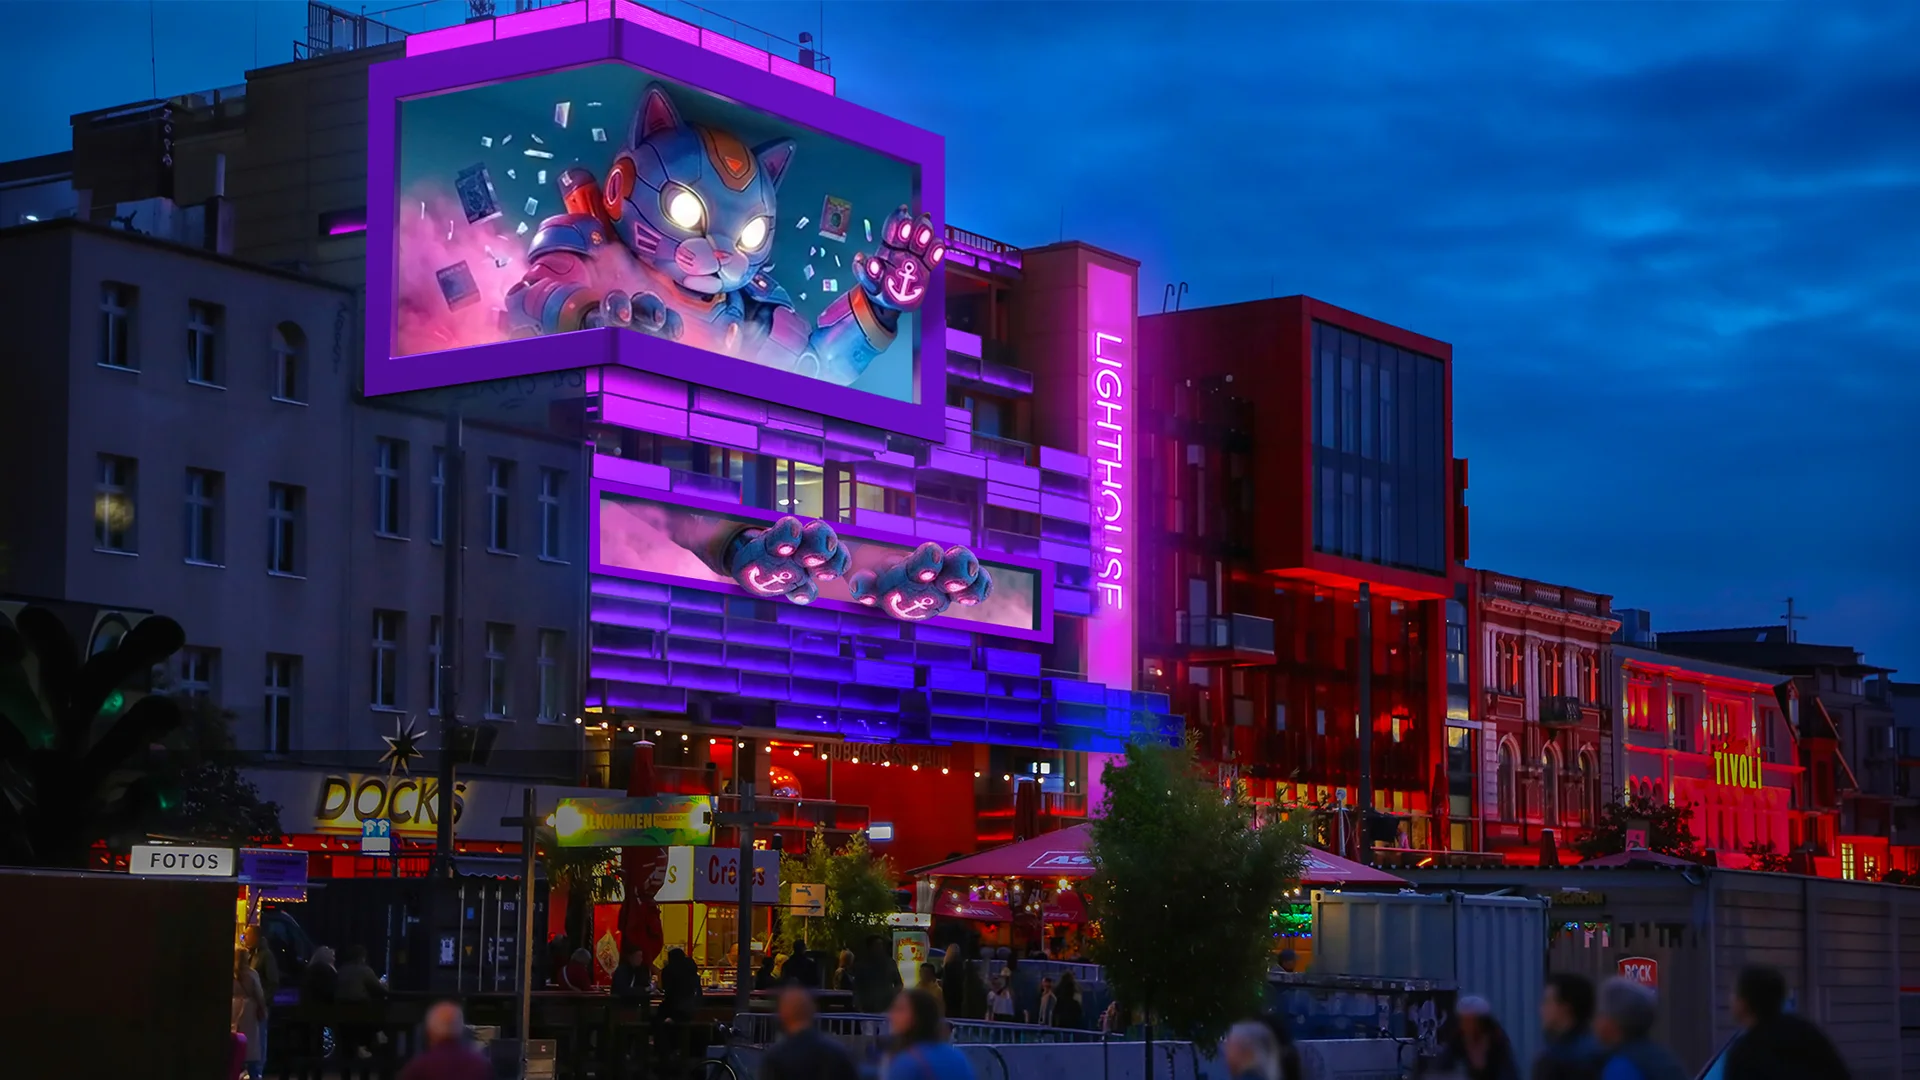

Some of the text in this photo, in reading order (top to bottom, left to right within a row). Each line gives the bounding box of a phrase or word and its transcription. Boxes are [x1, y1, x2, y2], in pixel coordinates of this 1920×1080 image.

[1094, 331, 1123, 610] LIGHTHOUSE
[815, 742, 888, 765] KUBHAUS
[150, 853, 219, 869] FOTOS
